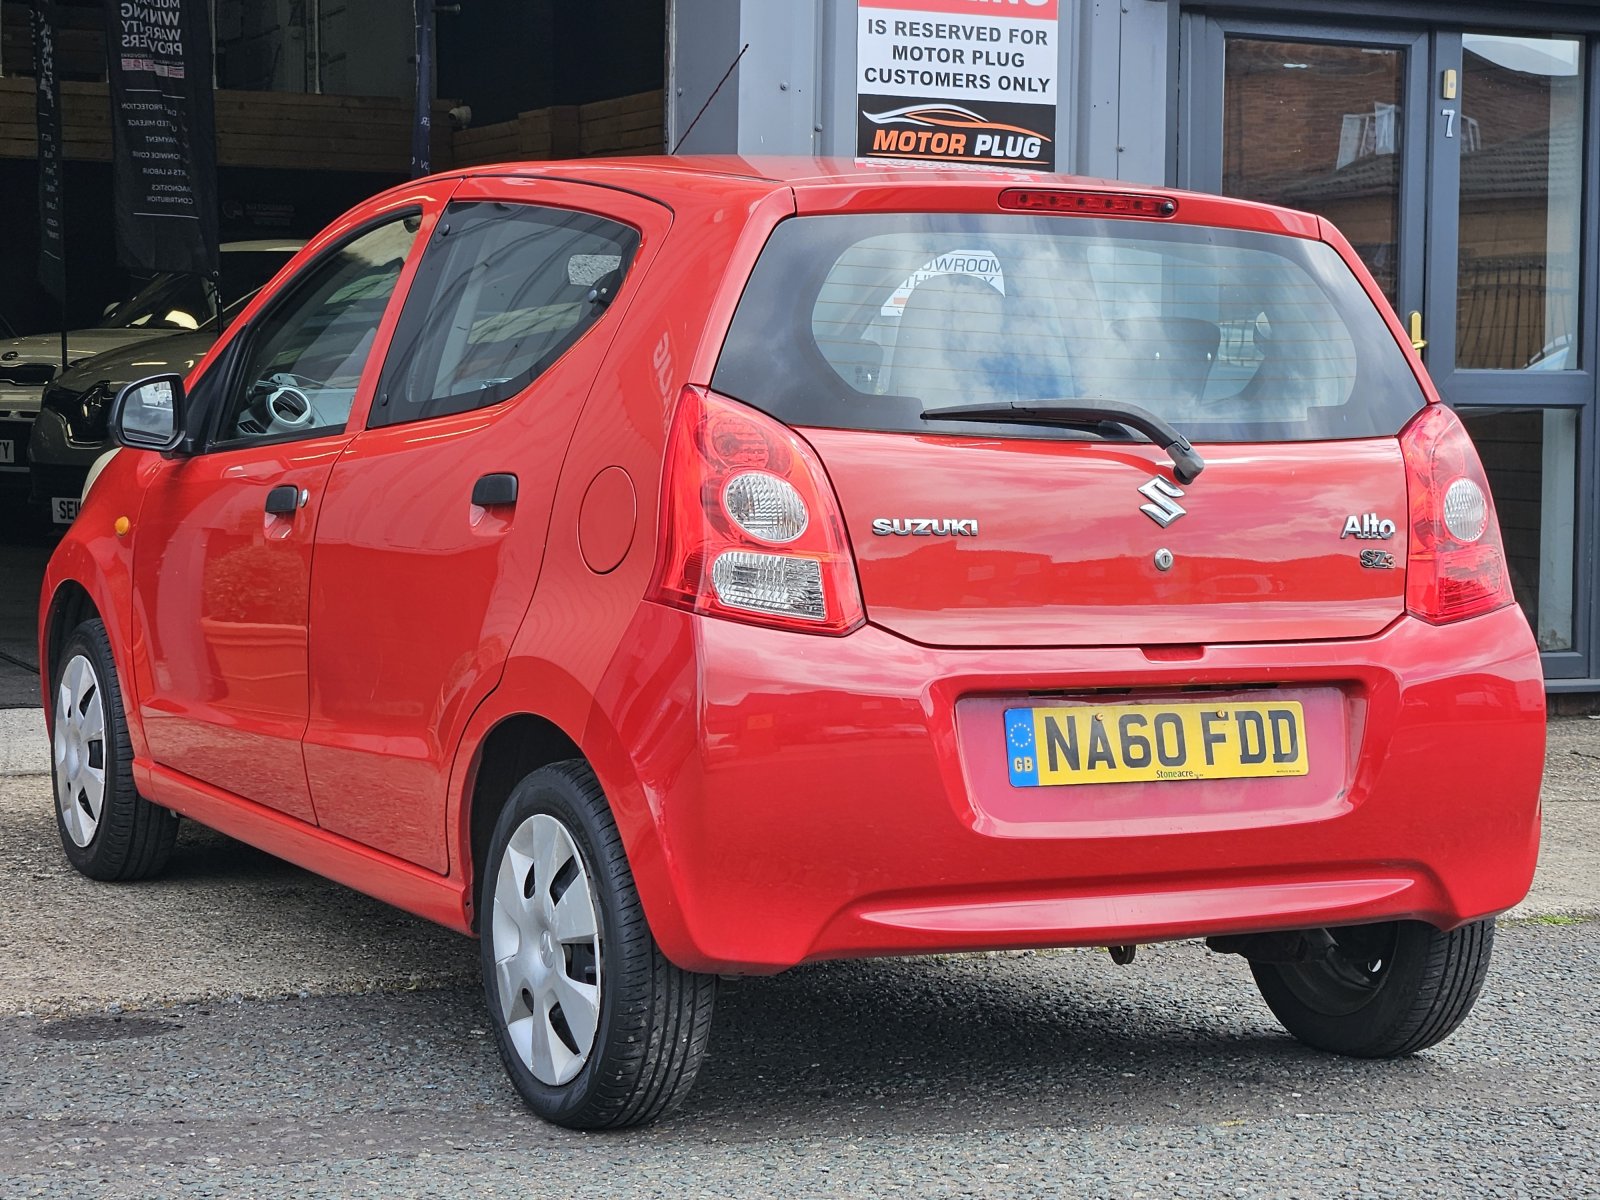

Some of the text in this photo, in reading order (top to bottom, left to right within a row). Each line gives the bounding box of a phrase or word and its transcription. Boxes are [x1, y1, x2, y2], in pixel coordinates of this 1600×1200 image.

[868, 18, 1048, 46] IS RESERVED FOR
[892, 45, 1026, 68] MOTOR PLUG
[864, 67, 1051, 93] CUSTOMERS ONLY
[1441, 109, 1456, 138] 7
[873, 129, 1042, 159] MOTOR PLUG
[872, 518, 978, 537] SUZUKI
[1340, 513, 1396, 540] Alto
[1360, 549, 1396, 569] SZ3
[1044, 709, 1300, 772] NA60 FDD
[1013, 757, 1034, 773] GB
[1156, 769, 1194, 779] Stoneacre
